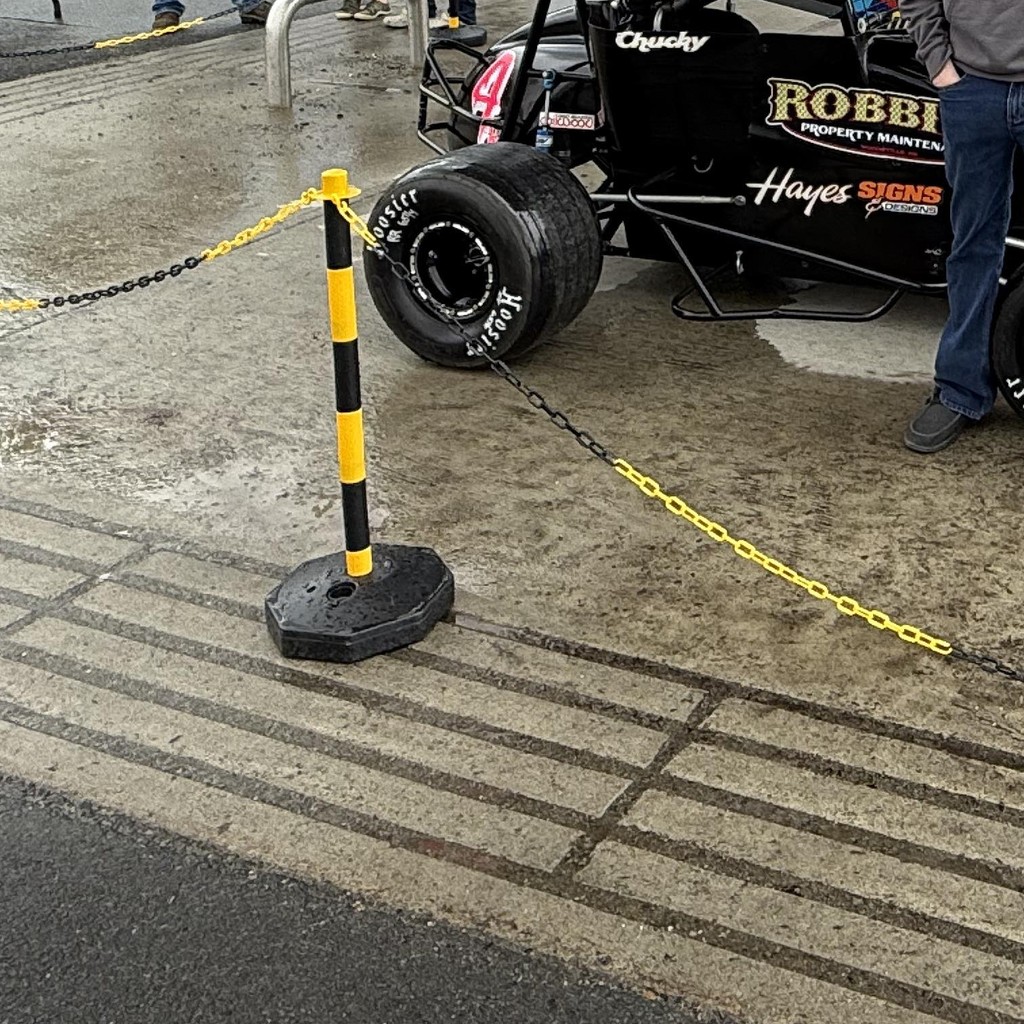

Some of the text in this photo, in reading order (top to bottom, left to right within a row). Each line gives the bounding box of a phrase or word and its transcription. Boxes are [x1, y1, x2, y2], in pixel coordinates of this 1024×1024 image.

[615, 30, 711, 53] Chucky
[772, 81, 941, 134] ROBBI
[801, 122, 874, 142] PROPERTY
[747, 166, 853, 217] Hayes
[857, 180, 943, 204] SIGNS
[884, 203, 938, 215] DESIGNS
